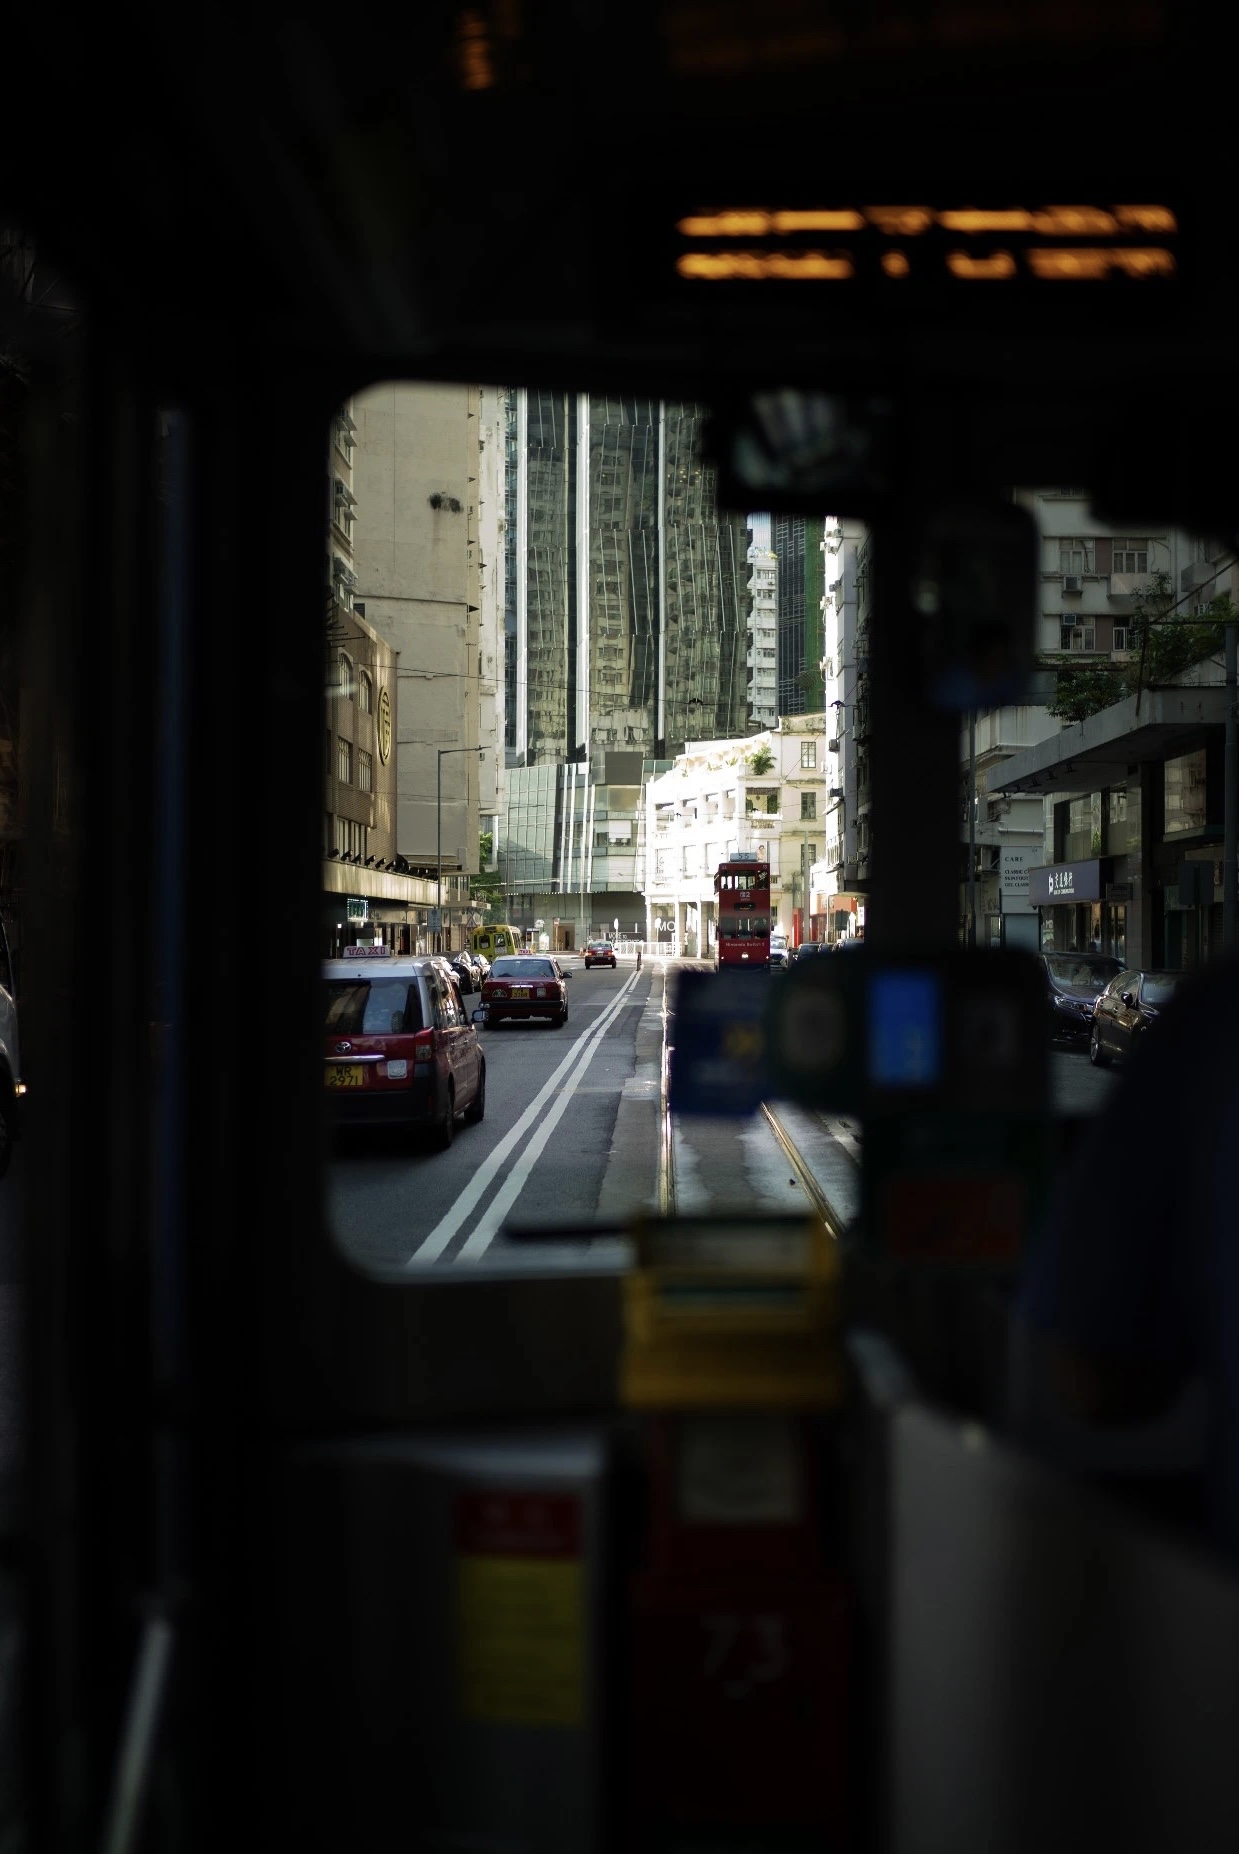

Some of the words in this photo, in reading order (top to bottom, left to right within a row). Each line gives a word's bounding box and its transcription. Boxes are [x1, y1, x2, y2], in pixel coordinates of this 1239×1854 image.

[347, 947, 386, 955] TAXI
[336, 1066, 352, 1076] WR
[329, 1075, 358, 1086] 2971
